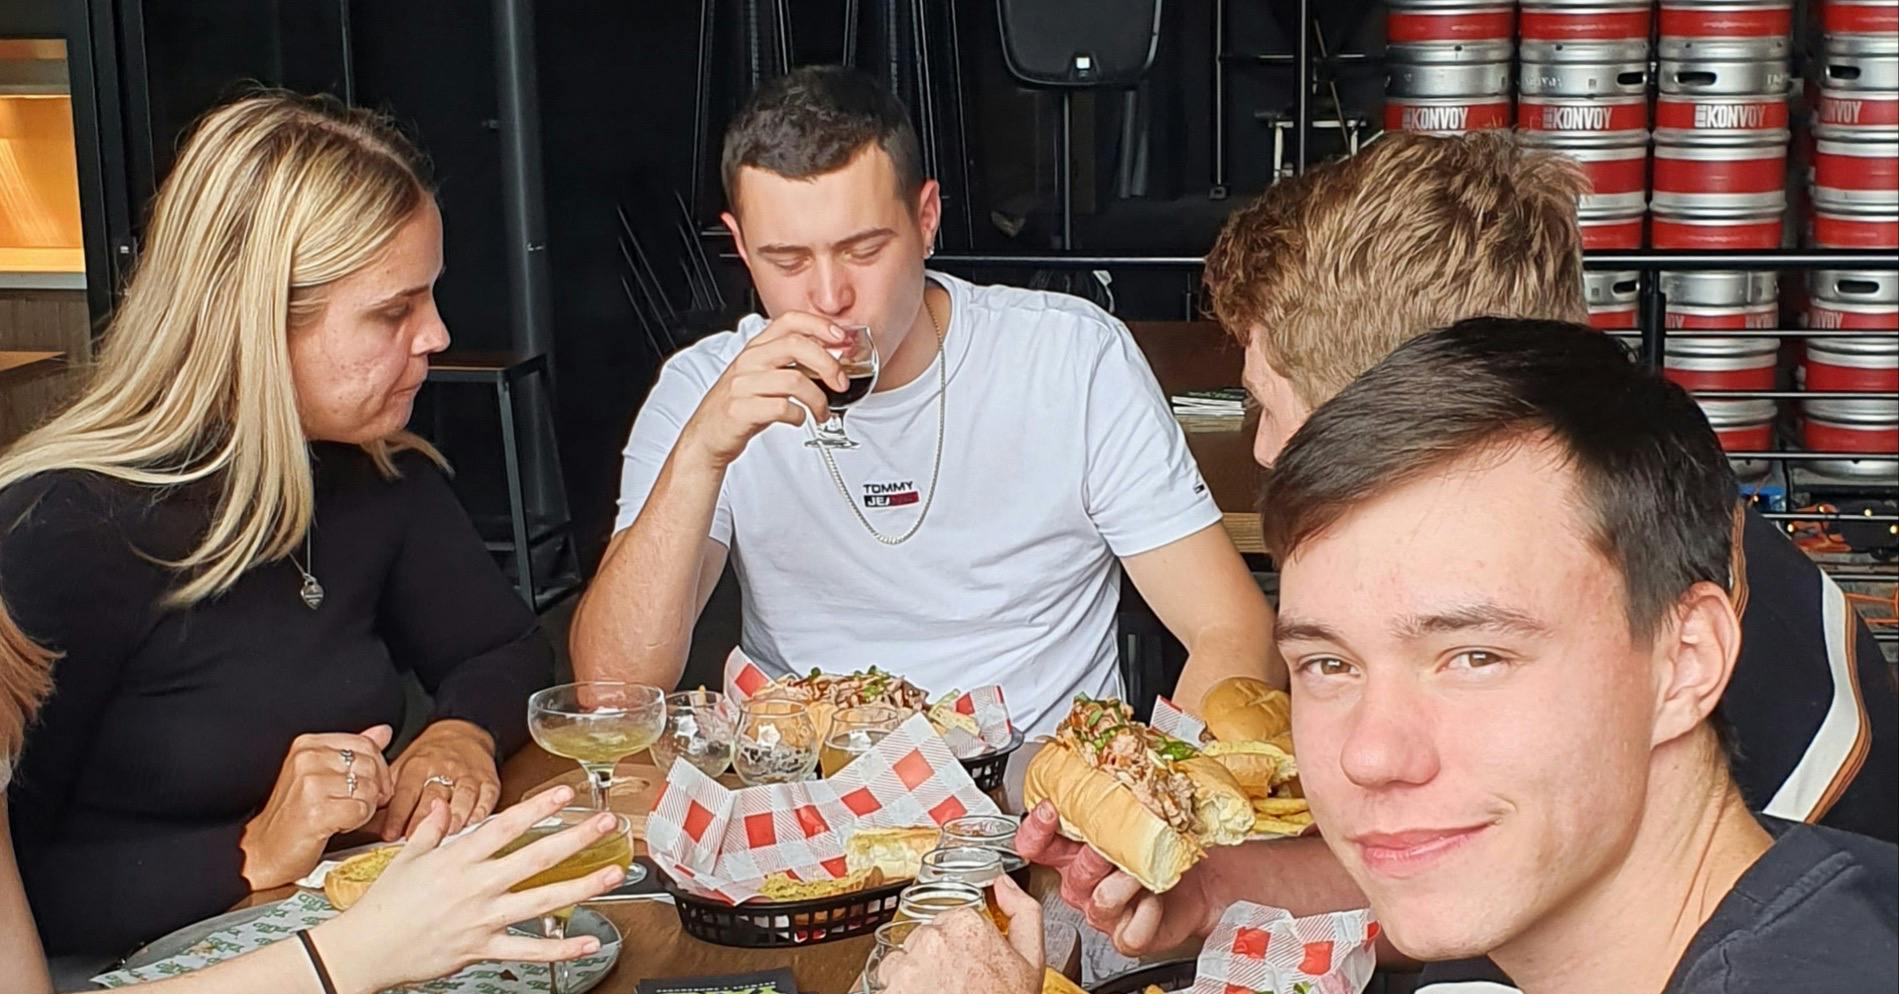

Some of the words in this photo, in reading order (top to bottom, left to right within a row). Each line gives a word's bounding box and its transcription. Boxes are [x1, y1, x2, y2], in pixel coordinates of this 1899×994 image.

[1411, 107, 1469, 129] KONVOY
[1554, 107, 1612, 129] KONVOY
[1707, 104, 1766, 128] KONVOY
[863, 481, 913, 494] TOMMY
